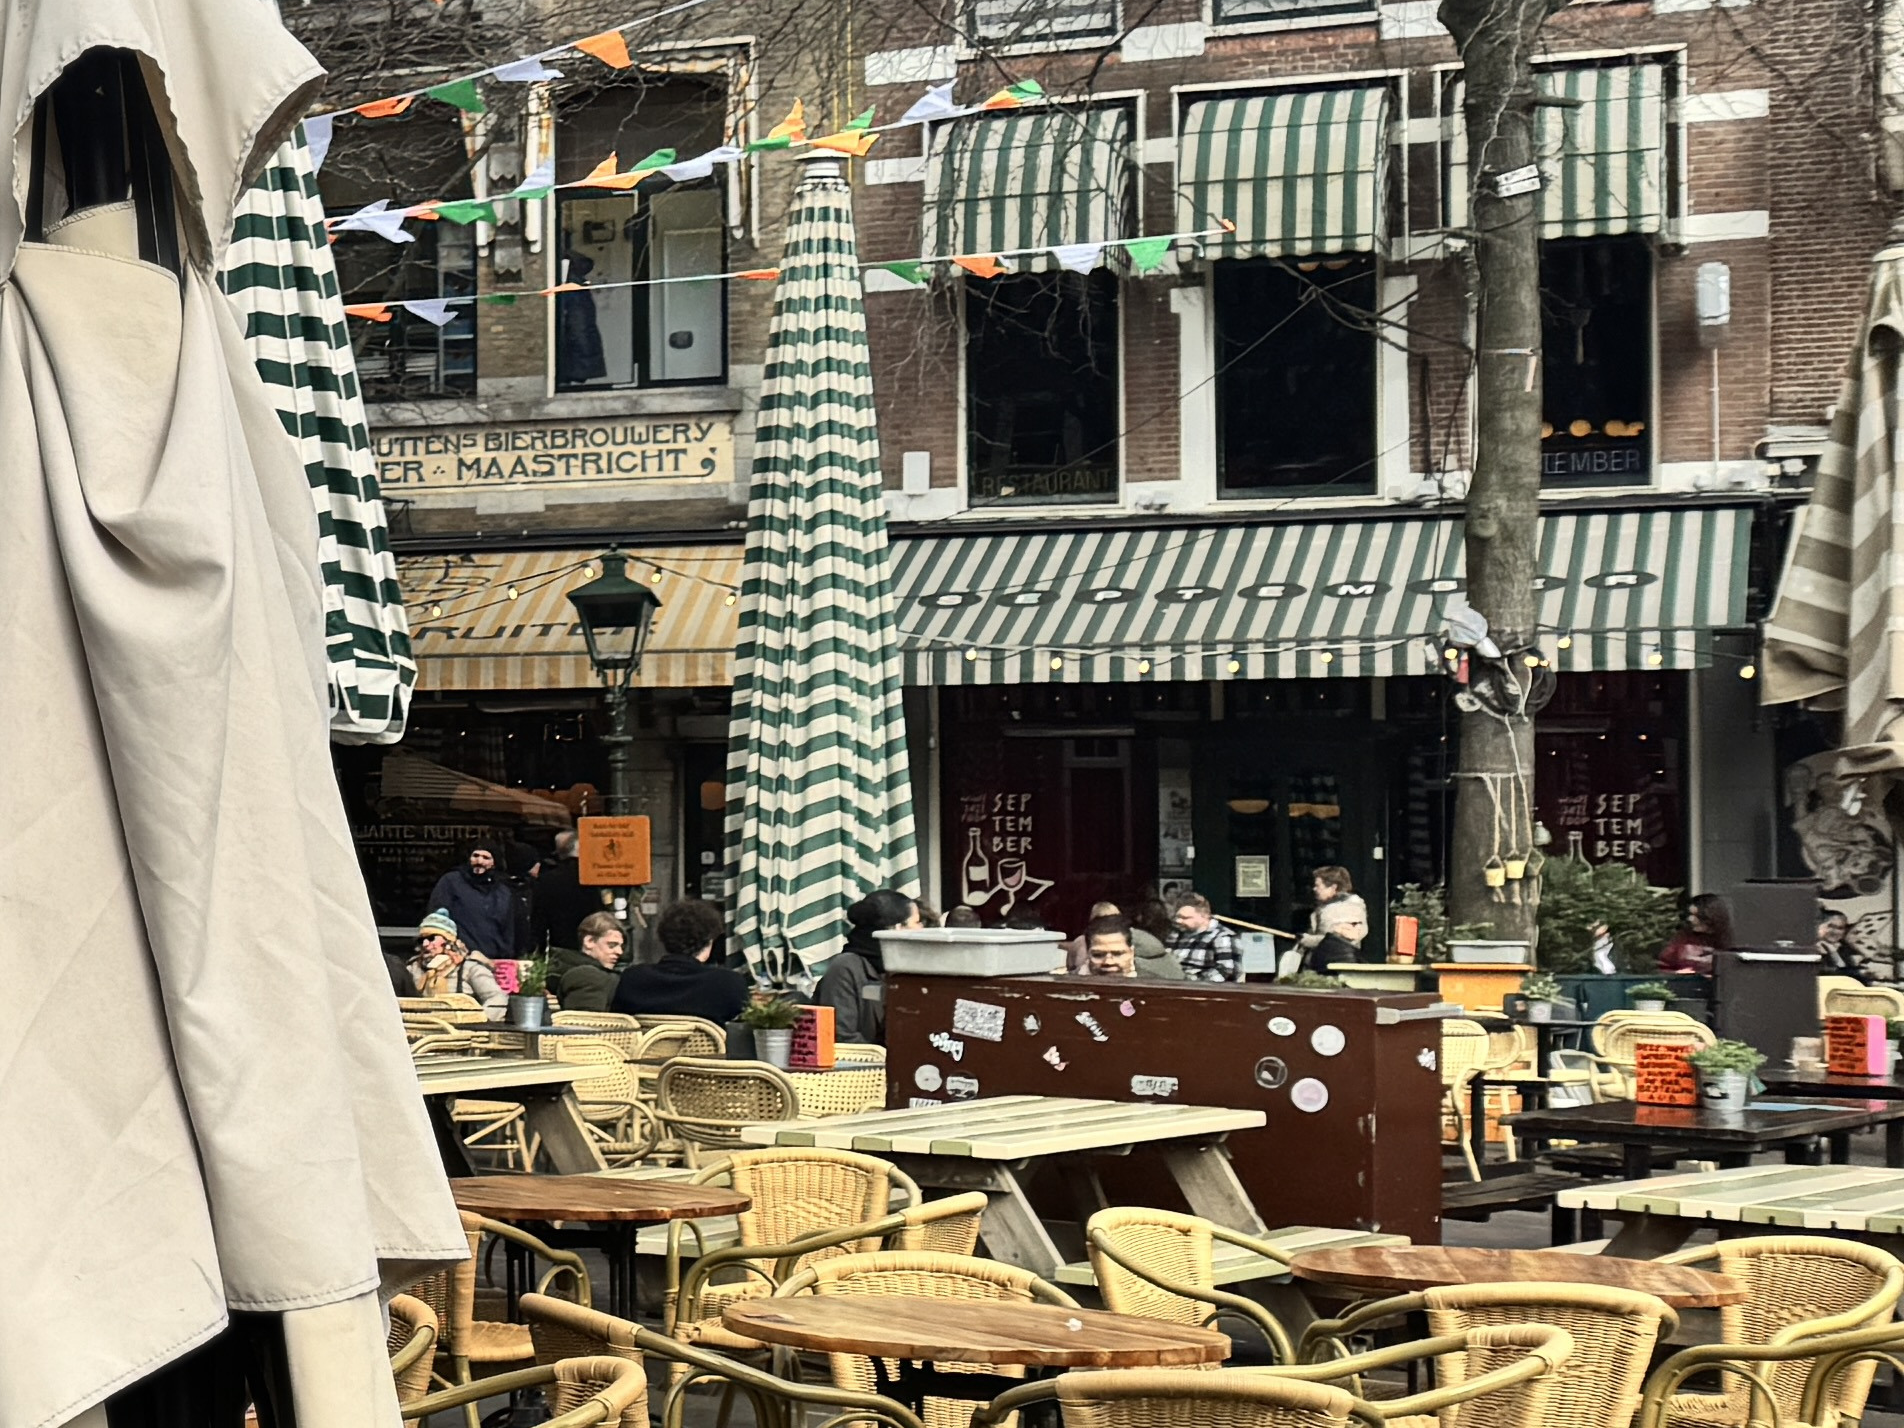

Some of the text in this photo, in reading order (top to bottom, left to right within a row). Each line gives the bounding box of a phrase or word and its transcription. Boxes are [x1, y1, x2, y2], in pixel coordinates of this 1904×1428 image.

[484, 421, 716, 452] BIERBROUWERY
[456, 447, 689, 480] MAASTRICHT
[992, 792, 1032, 813] SEP
[1596, 793, 1641, 815] SEP
[992, 815, 1033, 833] TEM
[1594, 818, 1643, 836] TEM
[992, 836, 1033, 855] BER
[1596, 840, 1645, 860] BER
